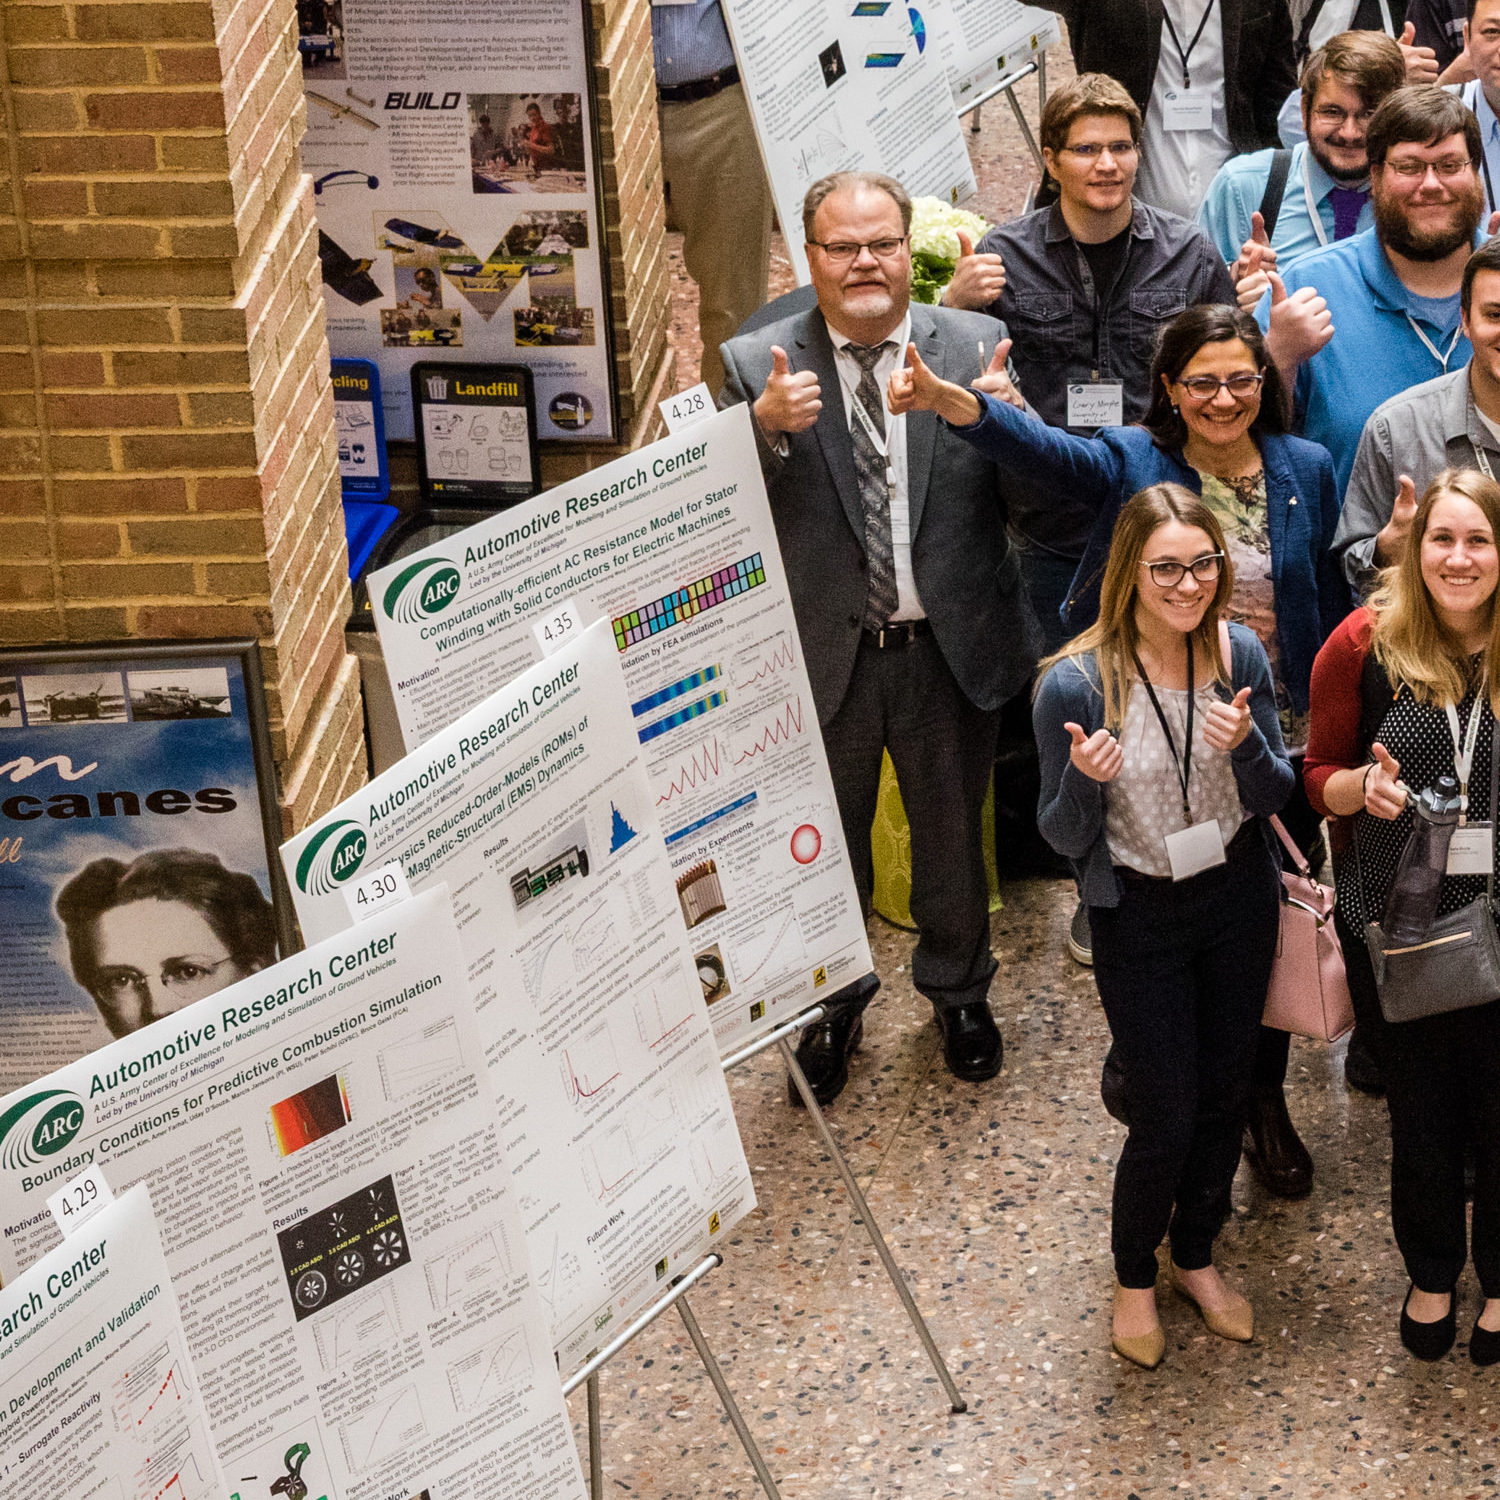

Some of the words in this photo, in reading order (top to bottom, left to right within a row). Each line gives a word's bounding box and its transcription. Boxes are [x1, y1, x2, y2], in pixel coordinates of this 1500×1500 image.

[384, 92, 461, 110] BUILD
[455, 380, 518, 397] Landfill
[671, 394, 705, 421] 4.28
[464, 510, 560, 566] Automotive
[565, 469, 647, 517] Research
[652, 442, 707, 477] Center
[420, 564, 560, 639] Computationally-efficient
[564, 553, 580, 570] AC
[583, 526, 647, 561] Resistance
[649, 506, 684, 531] Model
[686, 500, 702, 514] for
[704, 483, 737, 505] Stator
[423, 575, 459, 601] ARC
[435, 623, 484, 652] Winding
[486, 609, 511, 627] with
[513, 591, 542, 615] Solid
[544, 562, 610, 599] Conductors
[612, 552, 629, 567] for
[632, 532, 675, 558] Electric
[677, 506, 730, 536] Machines
[543, 611, 574, 642] 4.35
[369, 754, 455, 826] Automotive
[459, 700, 528, 760] Research
[532, 662, 578, 706] Center
[507, 776, 536, 808] (EMS)
[537, 743, 584, 783] Dynamics
[427, 756, 539, 842] Reduced-Order-Models
[541, 725, 576, 761] (ROMs)
[578, 715, 588, 732] of
[334, 835, 366, 875] ARC
[356, 873, 398, 907] 4.30
[90, 1024, 215, 1098] Automotive
[222, 969, 321, 1031] Research
[329, 932, 396, 977] Center
[94, 1103, 100, 1113] A
[101, 1096, 117, 1108] U.S.
[119, 1085, 140, 1100] Army
[142, 1071, 168, 1088] Center
[169, 1064, 178, 1075] of
[179, 1045, 221, 1070] Excellence
[222, 1038, 233, 1049] for
[235, 1021, 270, 1042] Modeling
[271, 1011, 285, 1025] and
[287, 993, 326, 1016] Simulation
[328, 986, 336, 996] of
[337, 972, 365, 991] Ground
[366, 957, 396, 976] Vehicles
[21, 1148, 94, 1192] Boundary
[99, 1107, 179, 1152] Conditions
[183, 1094, 203, 1112] for
[207, 1058, 278, 1099] Predictive
[282, 1013, 365, 1061] Combustion
[369, 975, 441, 1017] Simulation
[36, 1106, 82, 1148] ARC
[61, 1179, 99, 1218] 4.29
[46, 1240, 106, 1298] Center
[9, 1347, 82, 1413] Development
[85, 1326, 106, 1352] and
[107, 1284, 160, 1331] Validation
[18, 1426, 59, 1463] Surrogate
[60, 1392, 100, 1428] Reactivity
